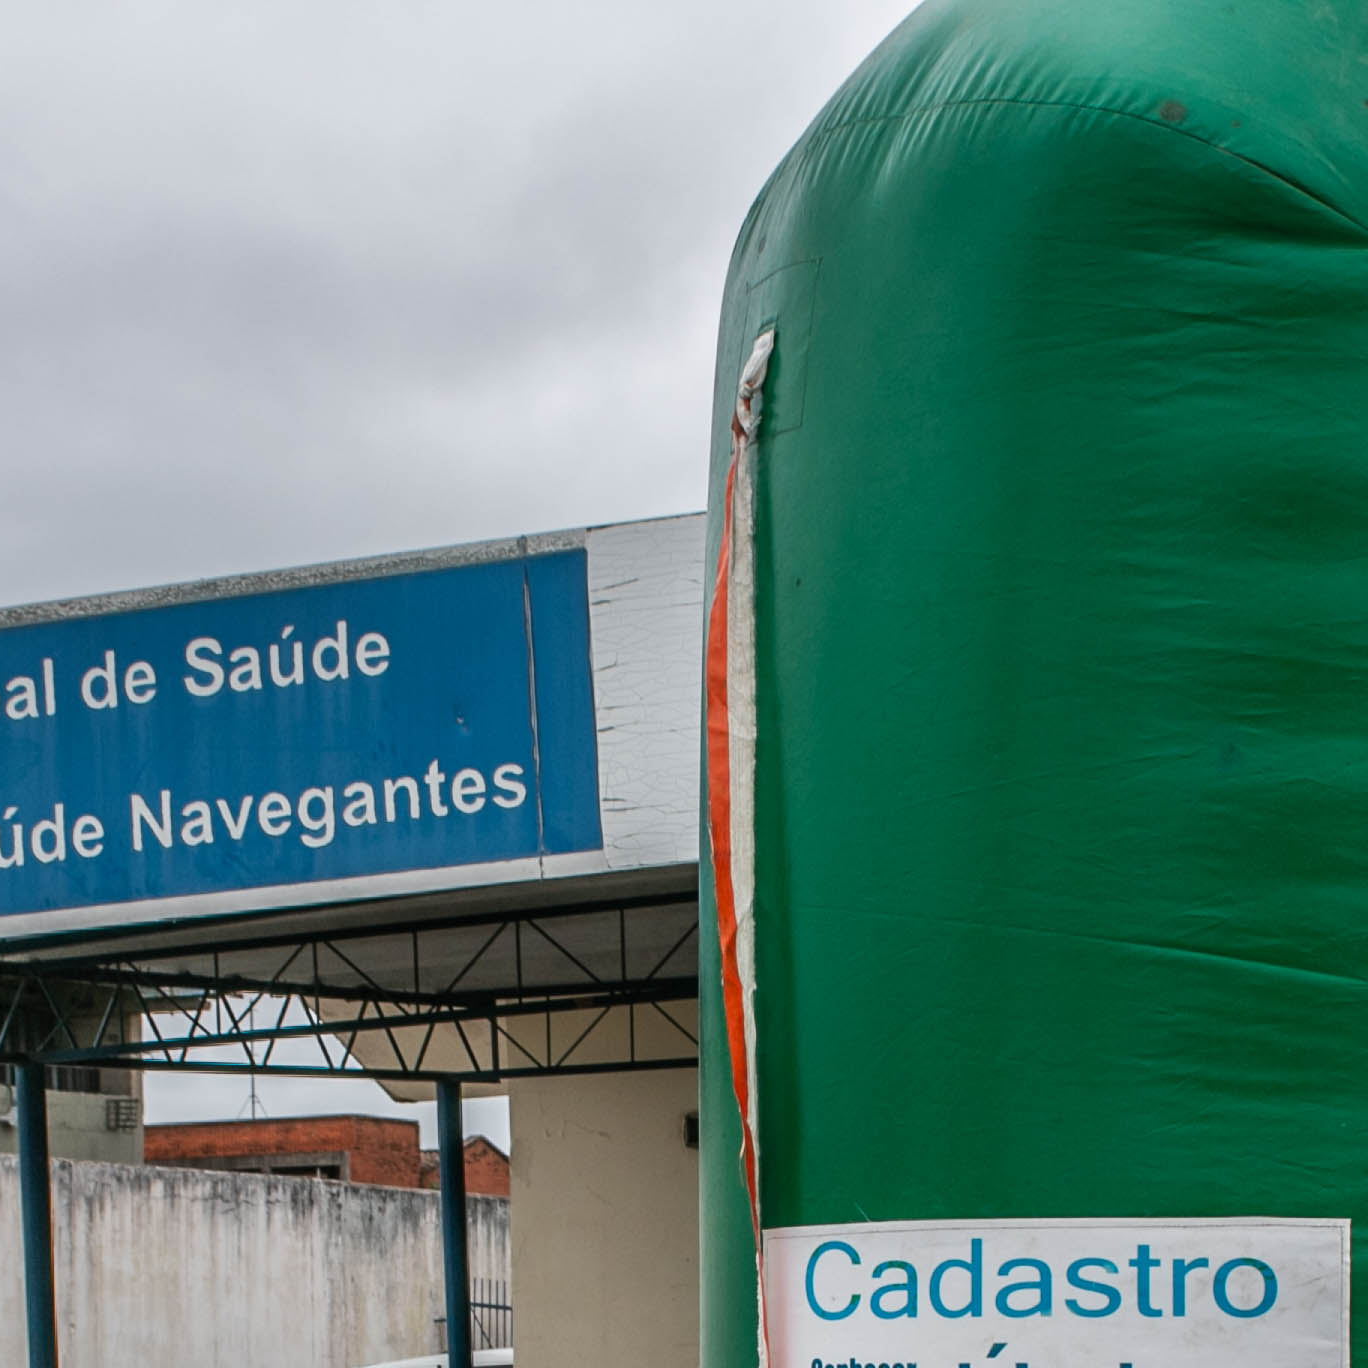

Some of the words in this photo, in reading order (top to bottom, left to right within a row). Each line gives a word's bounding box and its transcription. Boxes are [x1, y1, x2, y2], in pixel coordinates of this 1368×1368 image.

[82, 651, 155, 708] de
[184, 621, 389, 696] Saúde
[131, 760, 526, 851] Navegantes
[806, 1239, 1277, 1320] Cadastro
